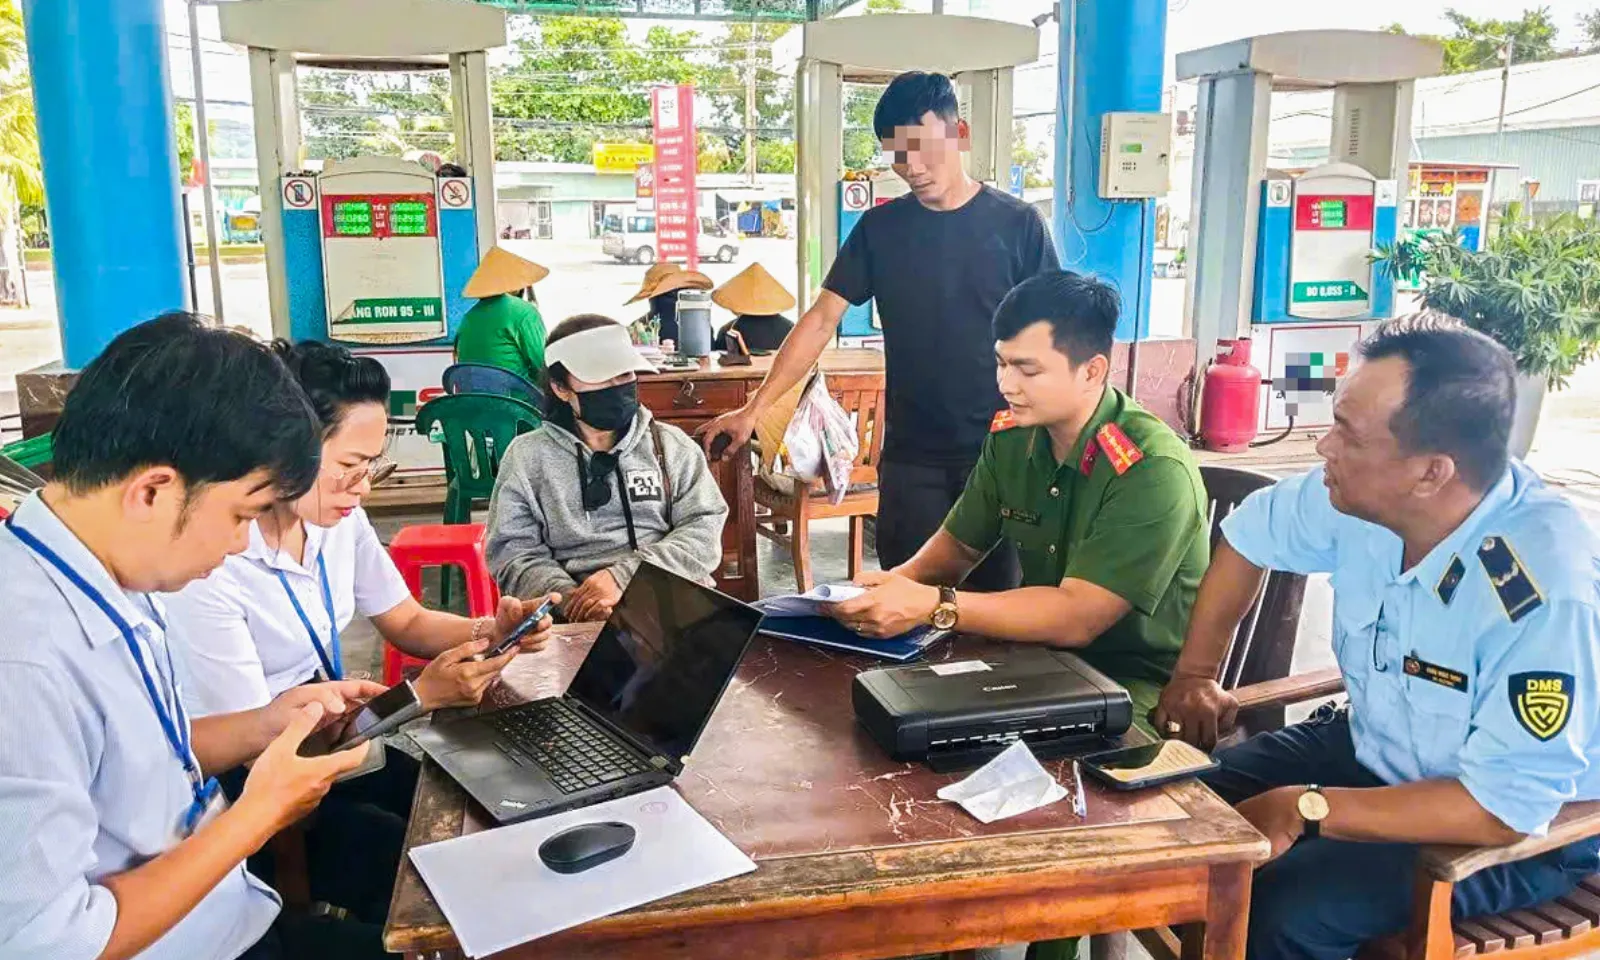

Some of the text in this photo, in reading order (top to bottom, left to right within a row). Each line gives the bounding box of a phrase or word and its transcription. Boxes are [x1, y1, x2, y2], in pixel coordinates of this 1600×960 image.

[352, 306, 372, 318] NG
[374, 305, 397, 318] RON
[400, 305, 414, 317] 95
[1527, 679, 1562, 692] DMS
